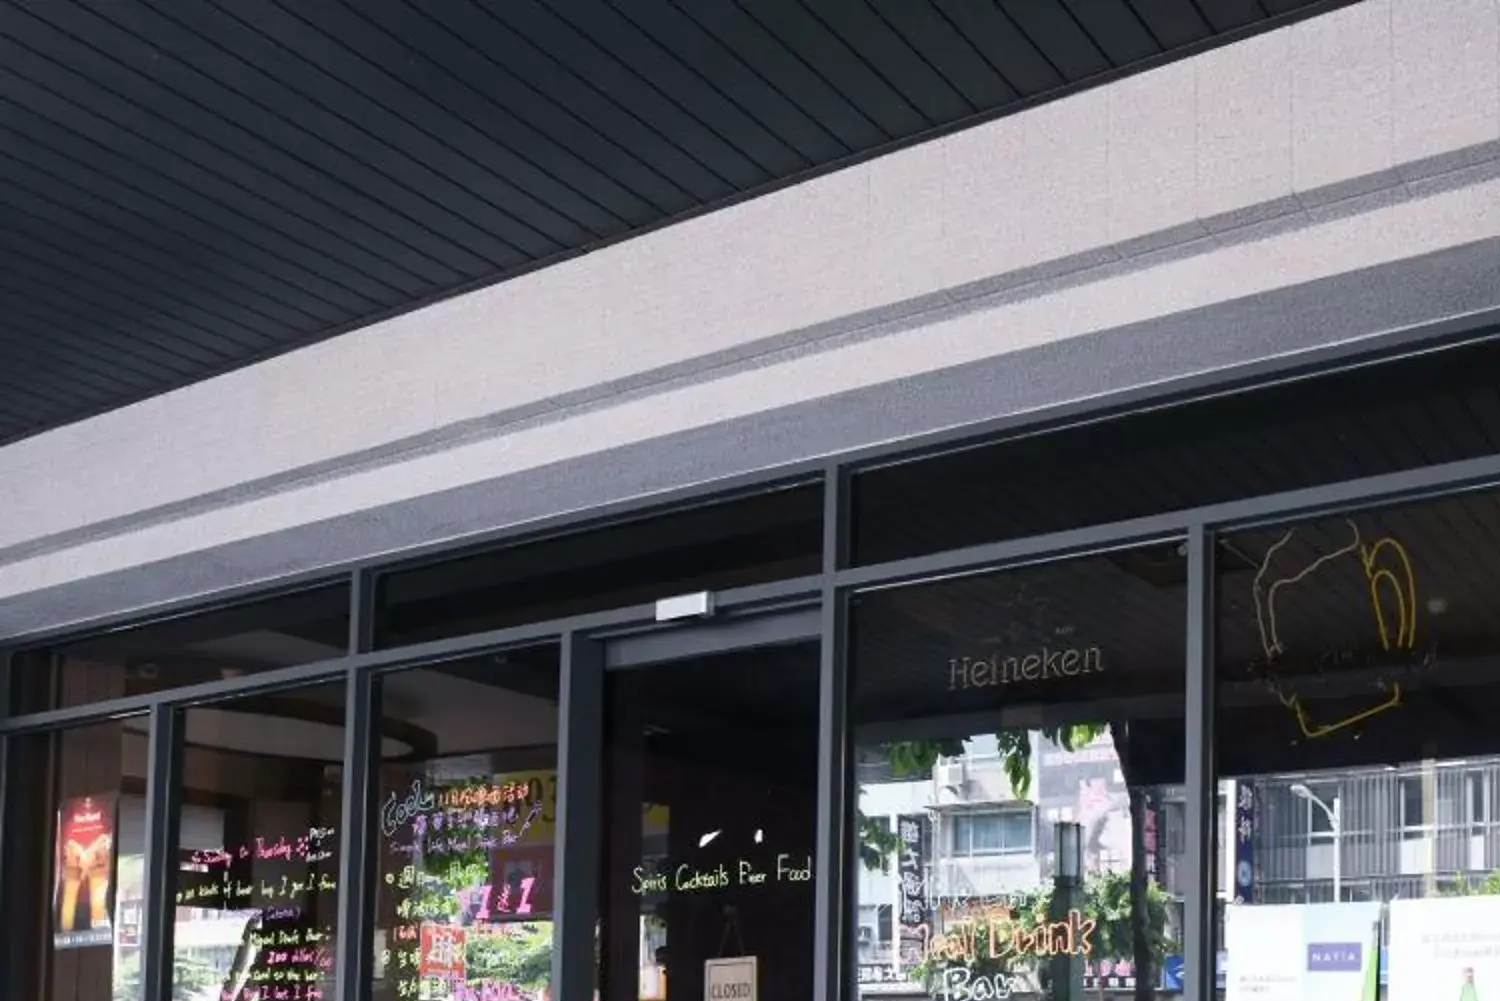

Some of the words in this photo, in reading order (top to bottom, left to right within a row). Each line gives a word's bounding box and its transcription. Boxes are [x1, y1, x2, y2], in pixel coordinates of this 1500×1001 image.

[947, 646, 1105, 691] Heineken
[776, 853, 812, 881] Food
[990, 908, 1096, 959] Drink
[711, 982, 751, 999] CLOSED
